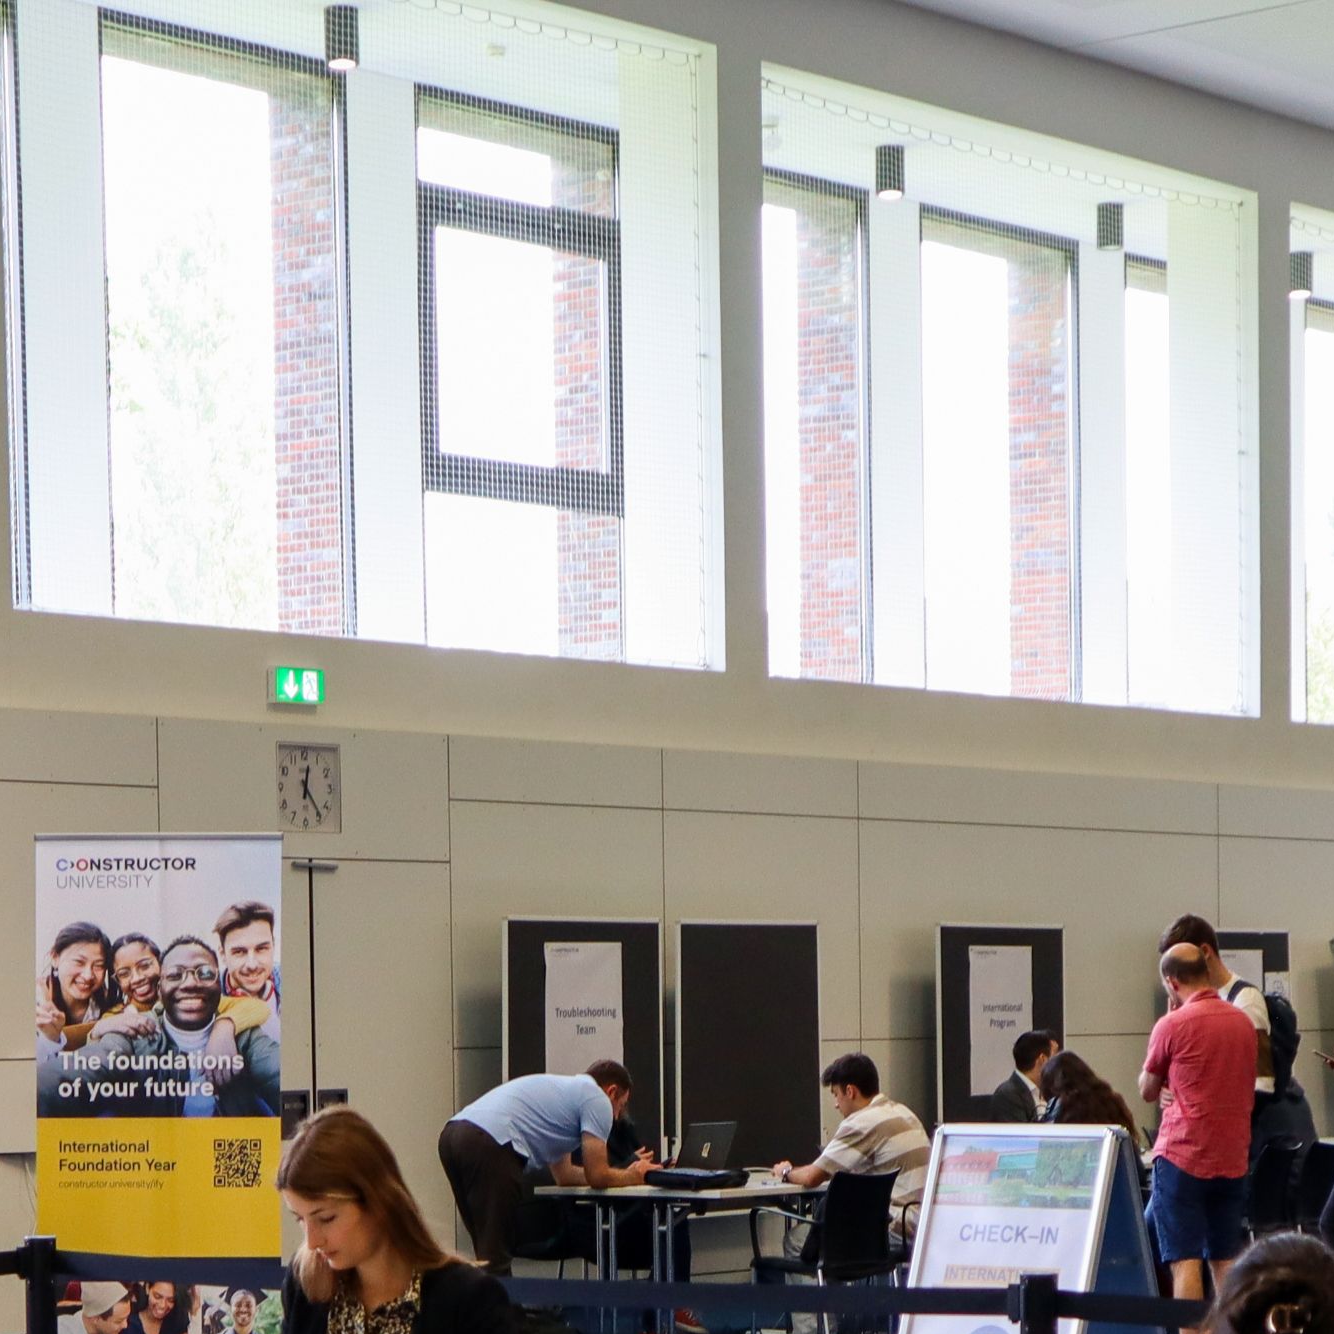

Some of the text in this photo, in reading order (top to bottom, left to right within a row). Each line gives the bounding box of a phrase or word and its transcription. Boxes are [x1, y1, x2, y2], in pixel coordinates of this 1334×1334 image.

[289, 754, 297, 766] 11
[301, 750, 308, 760] 12
[316, 754, 319, 766] 1
[281, 766, 289, 776] 10
[323, 767, 330, 778] 2
[278, 782, 284, 793] 9
[327, 784, 333, 794] 3
[323, 801, 329, 810] 4
[290, 811, 297, 824] 7
[303, 817, 309, 828] 6
[56, 874, 154, 889] UNIVERSITY
[555, 1006, 617, 1019] Troubleshooting
[983, 1003, 1023, 1013] International
[576, 1024, 596, 1035] Team
[60, 1050, 244, 1070] The foundations
[58, 1077, 214, 1102] of your future
[59, 1140, 149, 1153] International
[59, 1159, 177, 1172] Foundation Year
[58, 1179, 164, 1190] constructor.university/ify
